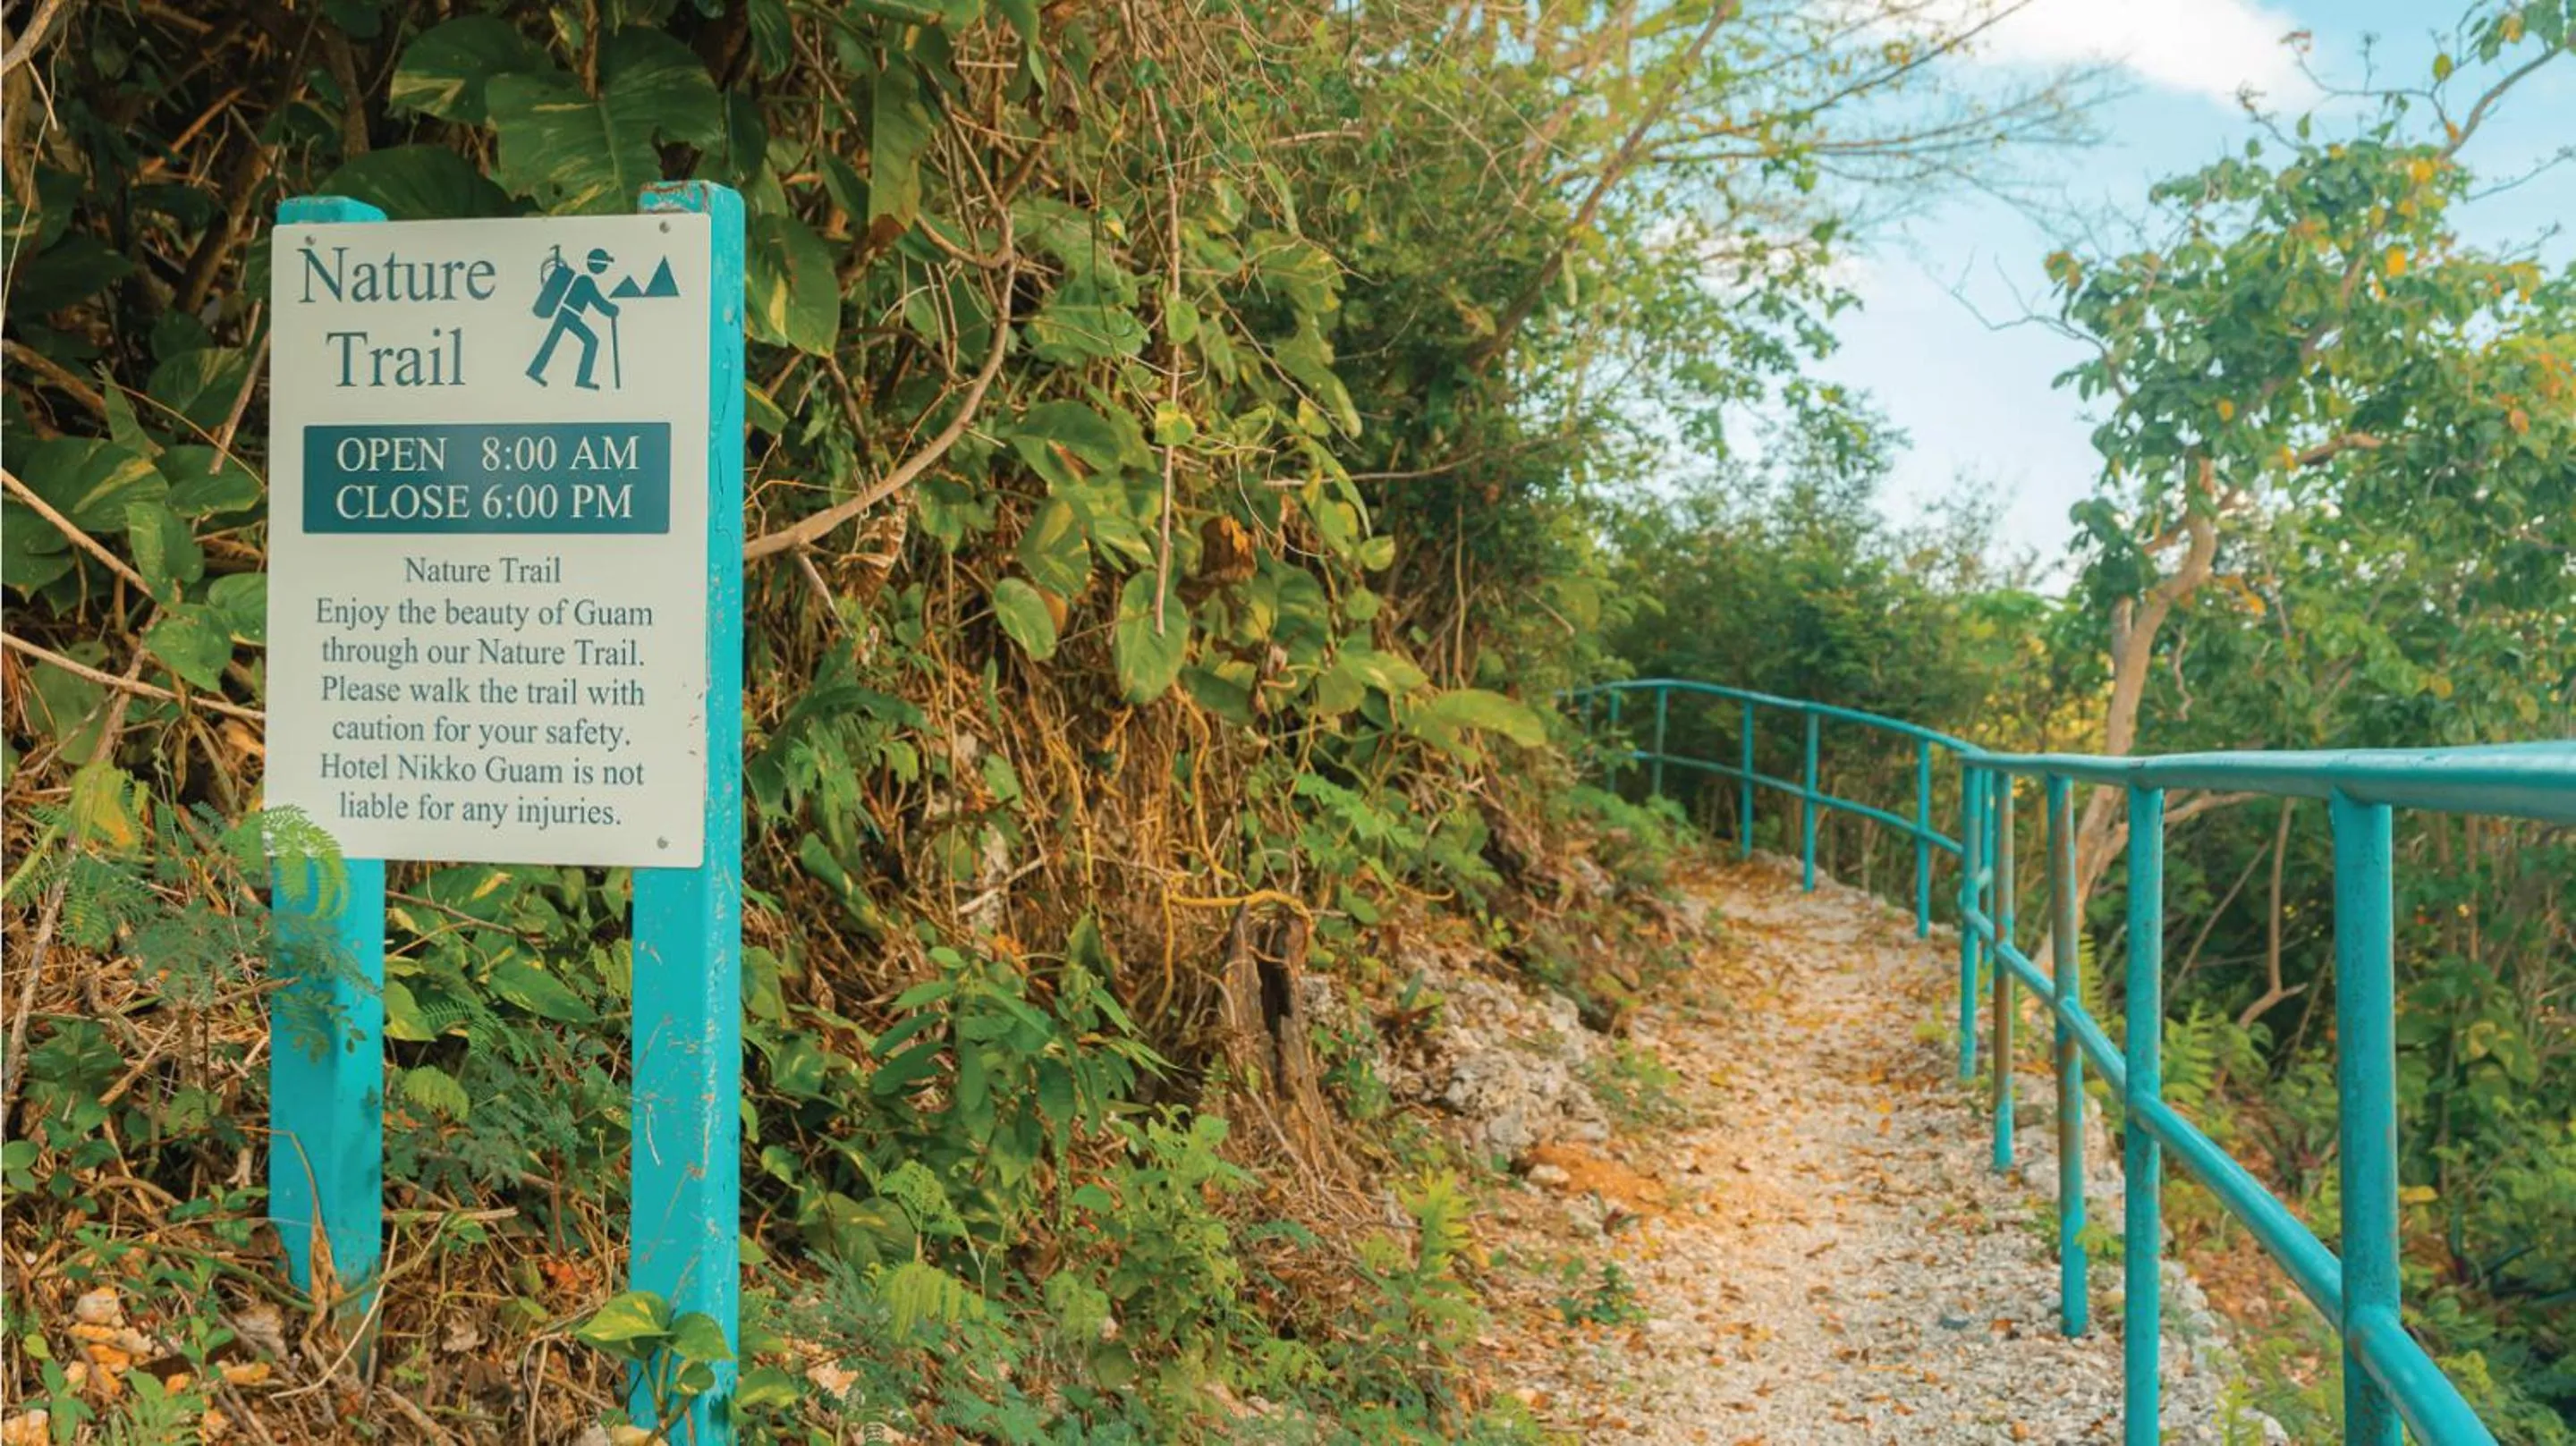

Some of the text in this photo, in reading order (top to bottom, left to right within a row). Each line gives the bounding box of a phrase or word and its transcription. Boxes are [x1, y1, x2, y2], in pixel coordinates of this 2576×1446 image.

[296, 246, 496, 304] Nature
[326, 327, 466, 387] Trail
[336, 435, 640, 471] OPEN 8:00 AM
[336, 484, 632, 519] CLOSE 6:00 PM
[405, 557, 561, 583] Nature Trail
[317, 597, 652, 631] Enjoy the beauty of Guam
[322, 636, 645, 671] through our Nature Trail.
[322, 676, 645, 706] Please walk the trail with
[332, 715, 631, 752] caution for your safety.
[321, 753, 645, 785] Hotel Nikko Guam is not
[340, 791, 622, 831] liable for any injuries.
